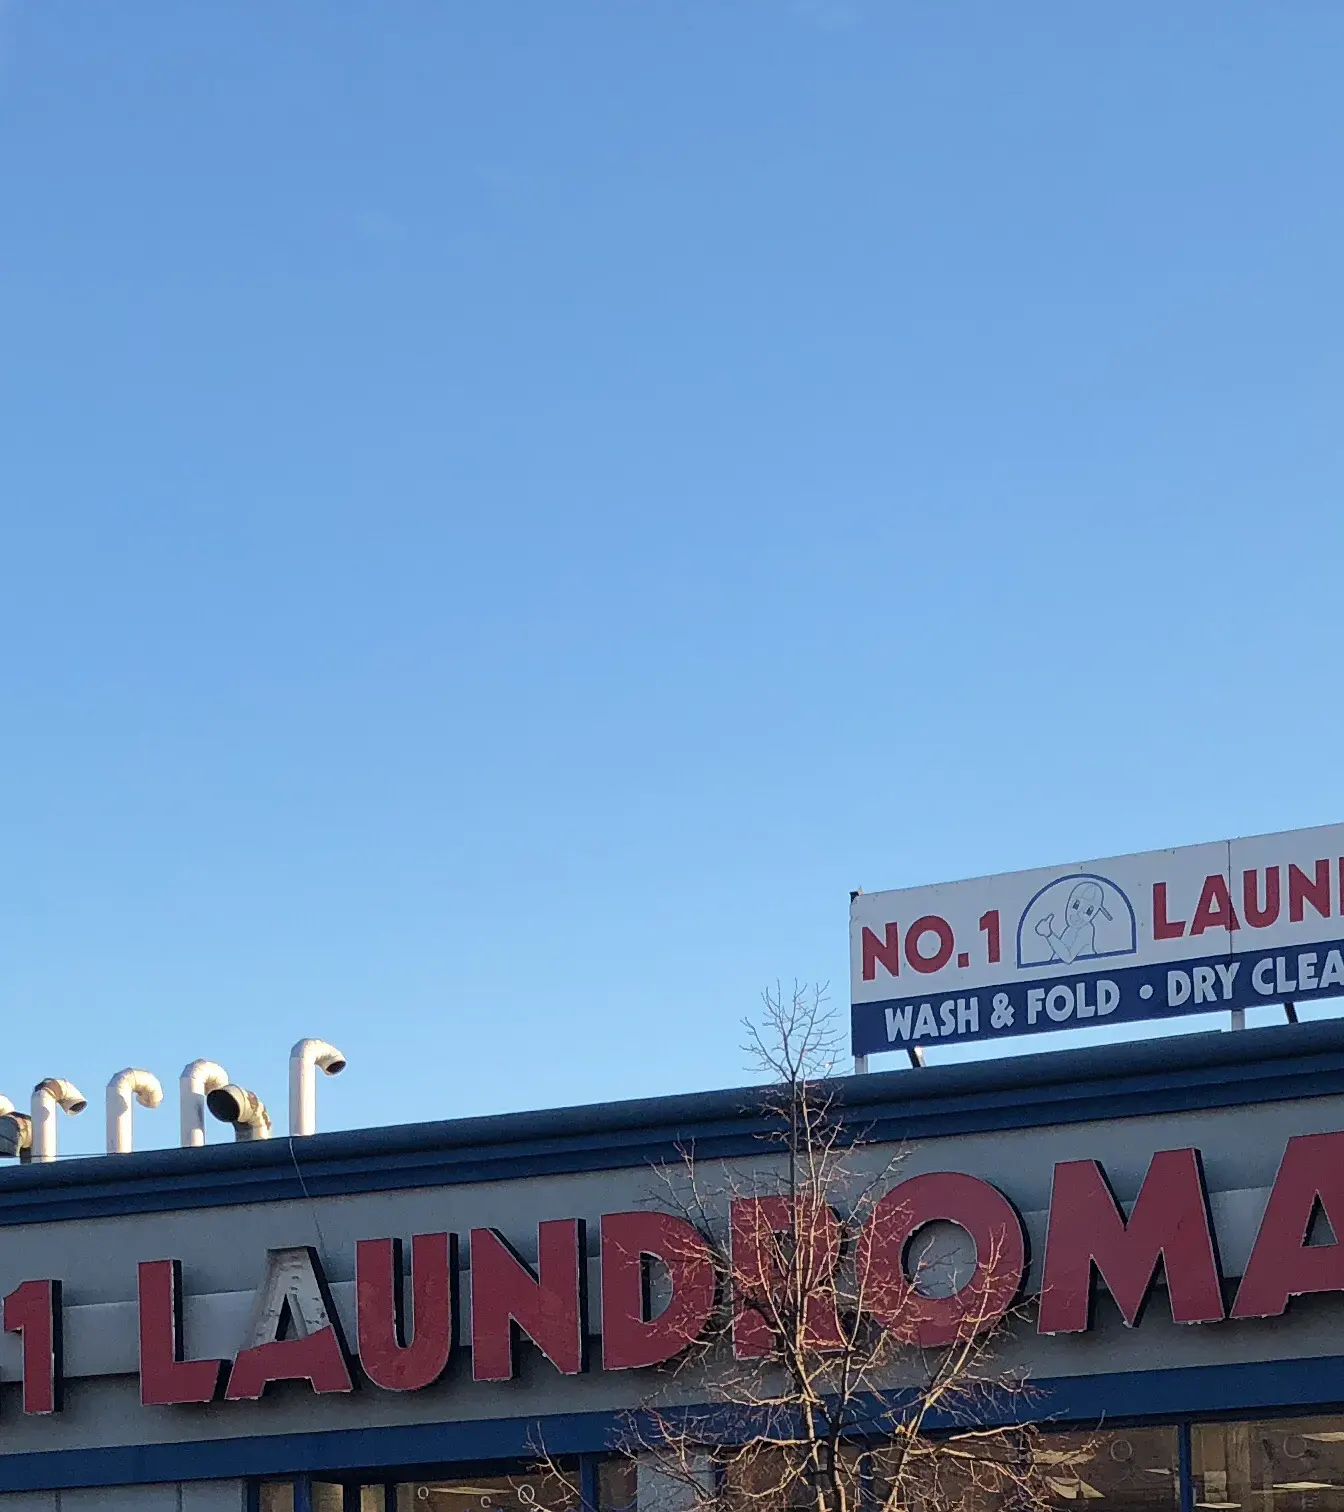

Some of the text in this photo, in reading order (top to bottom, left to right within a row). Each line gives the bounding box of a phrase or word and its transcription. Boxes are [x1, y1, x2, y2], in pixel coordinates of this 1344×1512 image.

[861, 909, 1001, 982] NO.1
[884, 996, 979, 1043] WASH
[991, 990, 1016, 1028] &
[1026, 979, 1121, 1022] FOLD
[1167, 962, 1236, 1008] DRY
